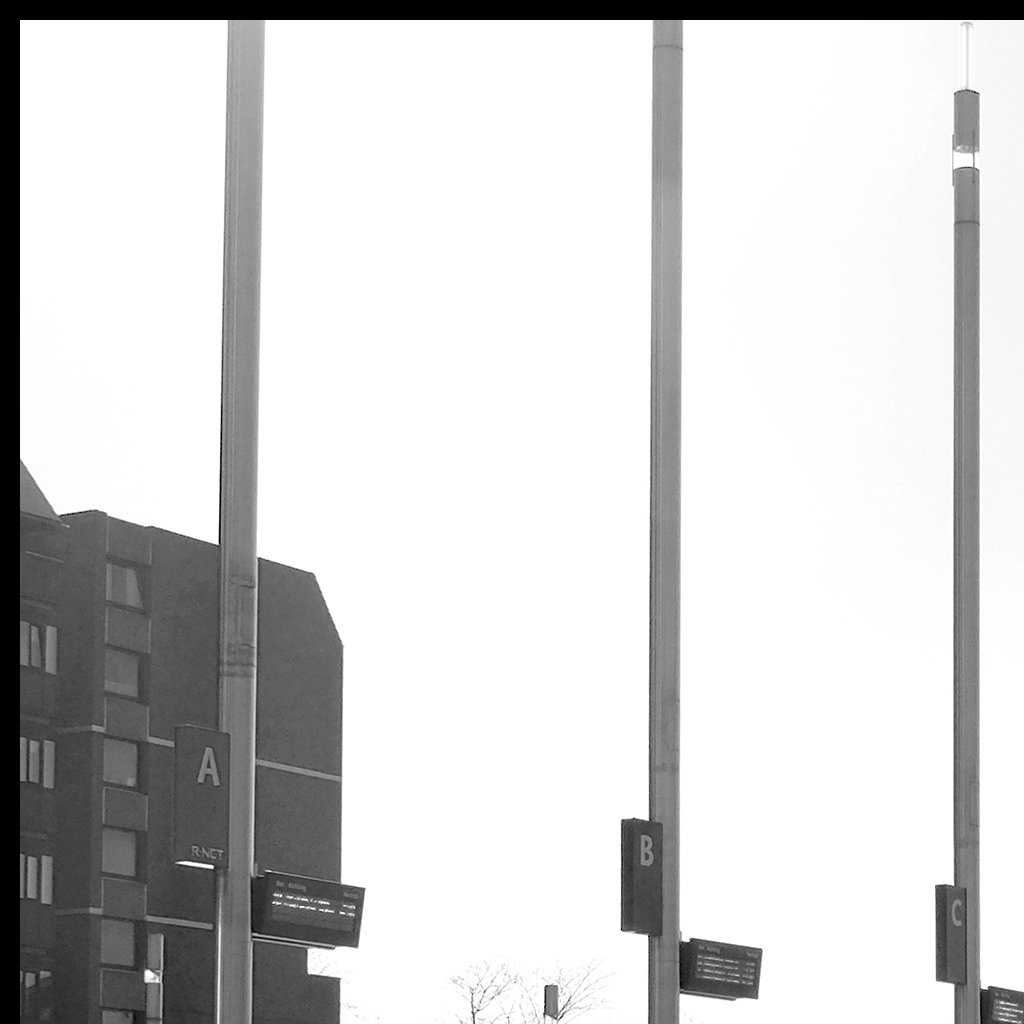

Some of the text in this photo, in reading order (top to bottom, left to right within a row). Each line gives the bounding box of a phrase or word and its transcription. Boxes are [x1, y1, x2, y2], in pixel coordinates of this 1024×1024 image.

[197, 746, 221, 787] A
[640, 834, 654, 867] B
[951, 899, 962, 927] C
